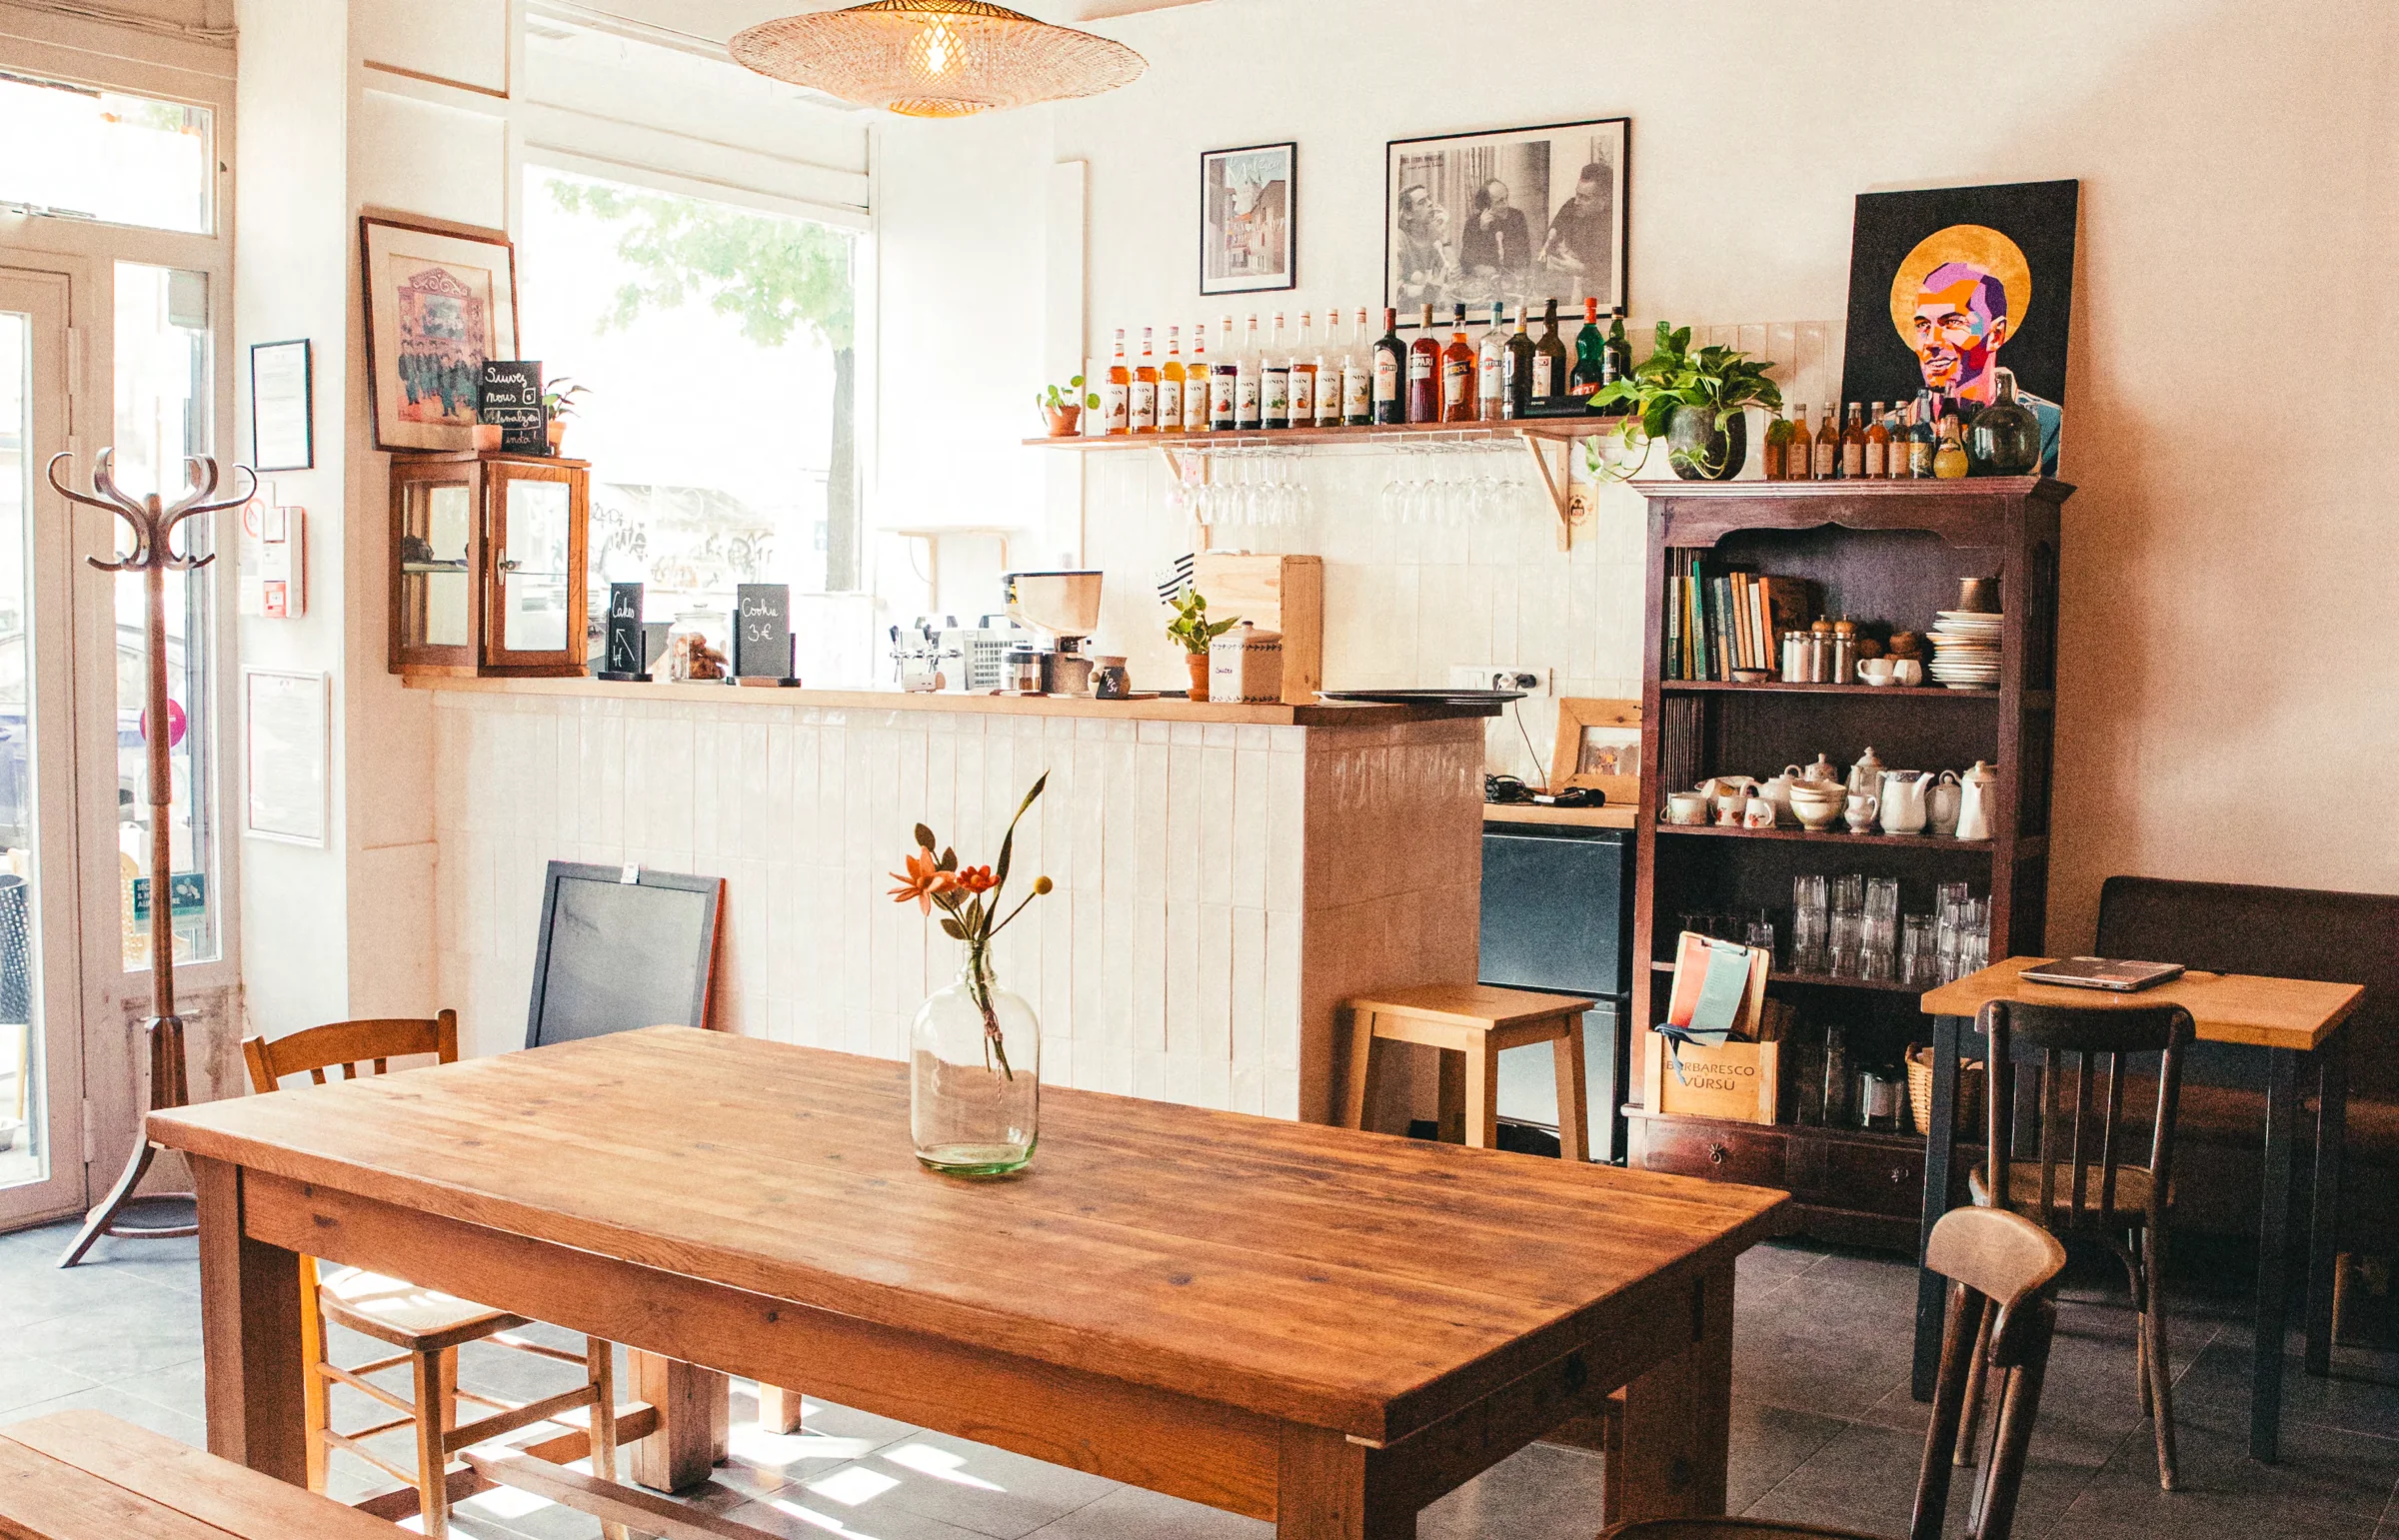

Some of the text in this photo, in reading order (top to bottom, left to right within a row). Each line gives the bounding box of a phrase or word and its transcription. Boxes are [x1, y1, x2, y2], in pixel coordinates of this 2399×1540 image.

[486, 391, 517, 404] nous
[741, 597, 779, 618] Cookie
[1666, 1060, 1755, 1076] BRBARESCO
[1683, 1074, 1735, 1091] VÜRSÜ
